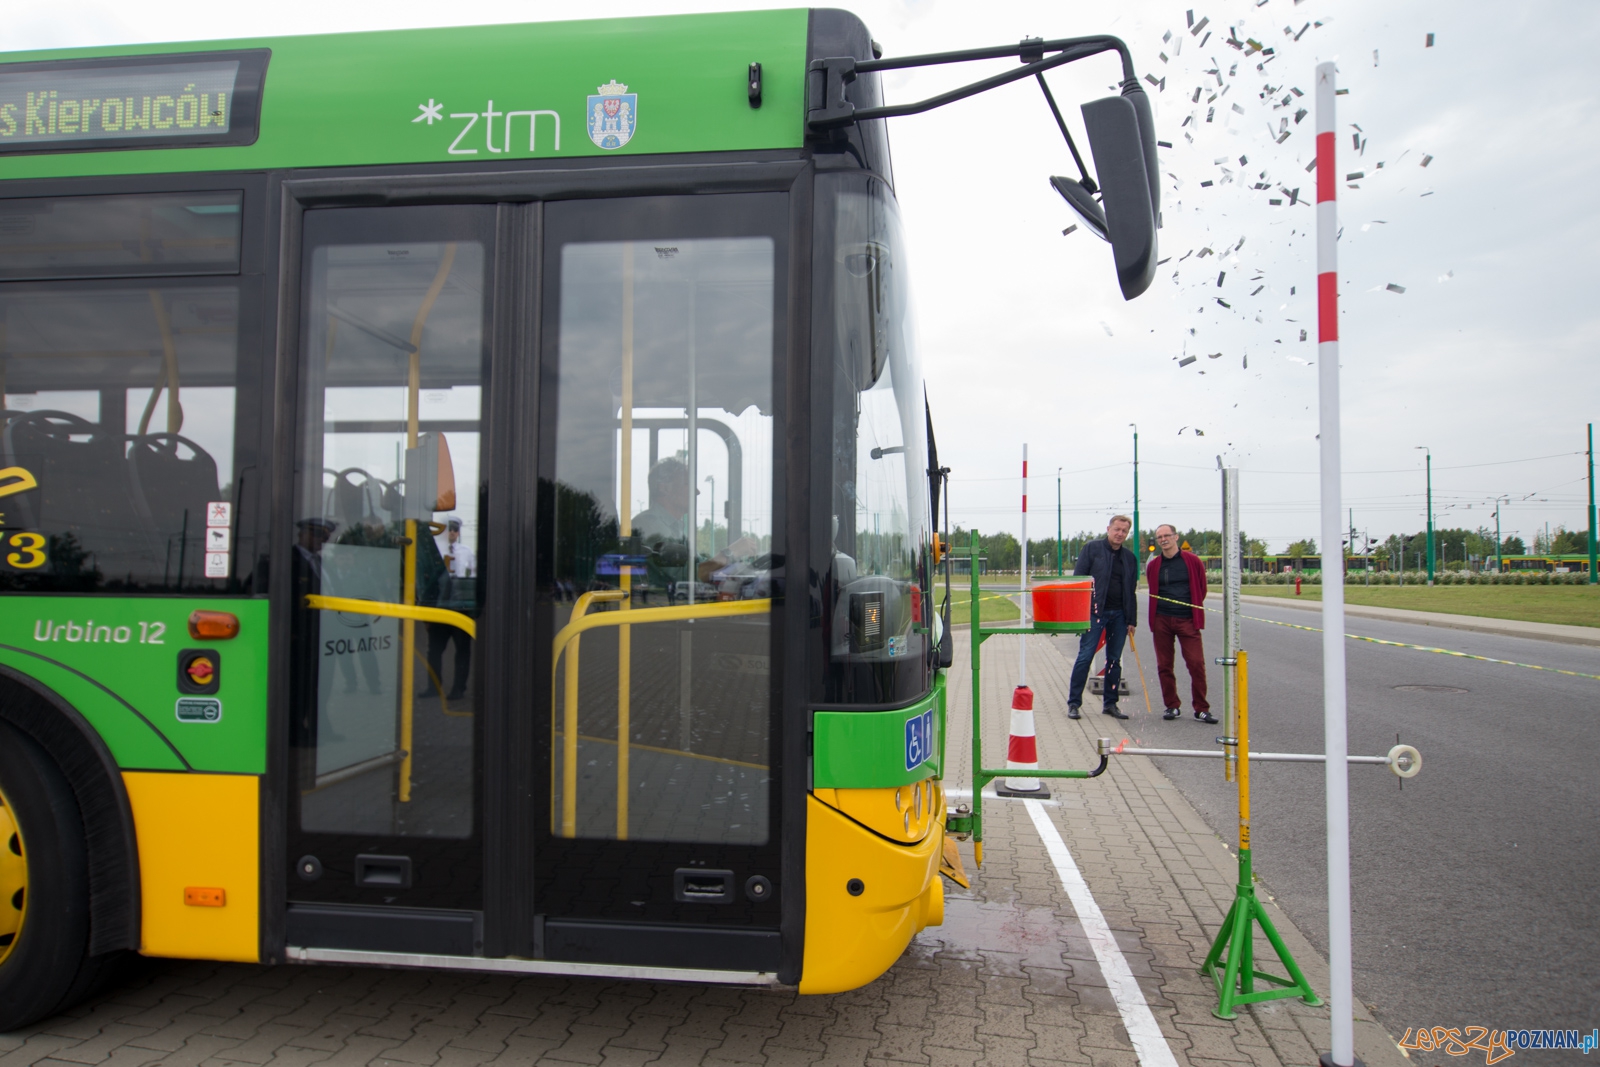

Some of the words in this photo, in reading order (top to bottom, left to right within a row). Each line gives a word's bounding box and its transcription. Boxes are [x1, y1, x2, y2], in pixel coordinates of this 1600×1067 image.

[25, 83, 226, 135] Kierowców
[33, 619, 131, 643] Urbino
[138, 621, 166, 644] 12
[323, 635, 392, 656] SOLARIS
